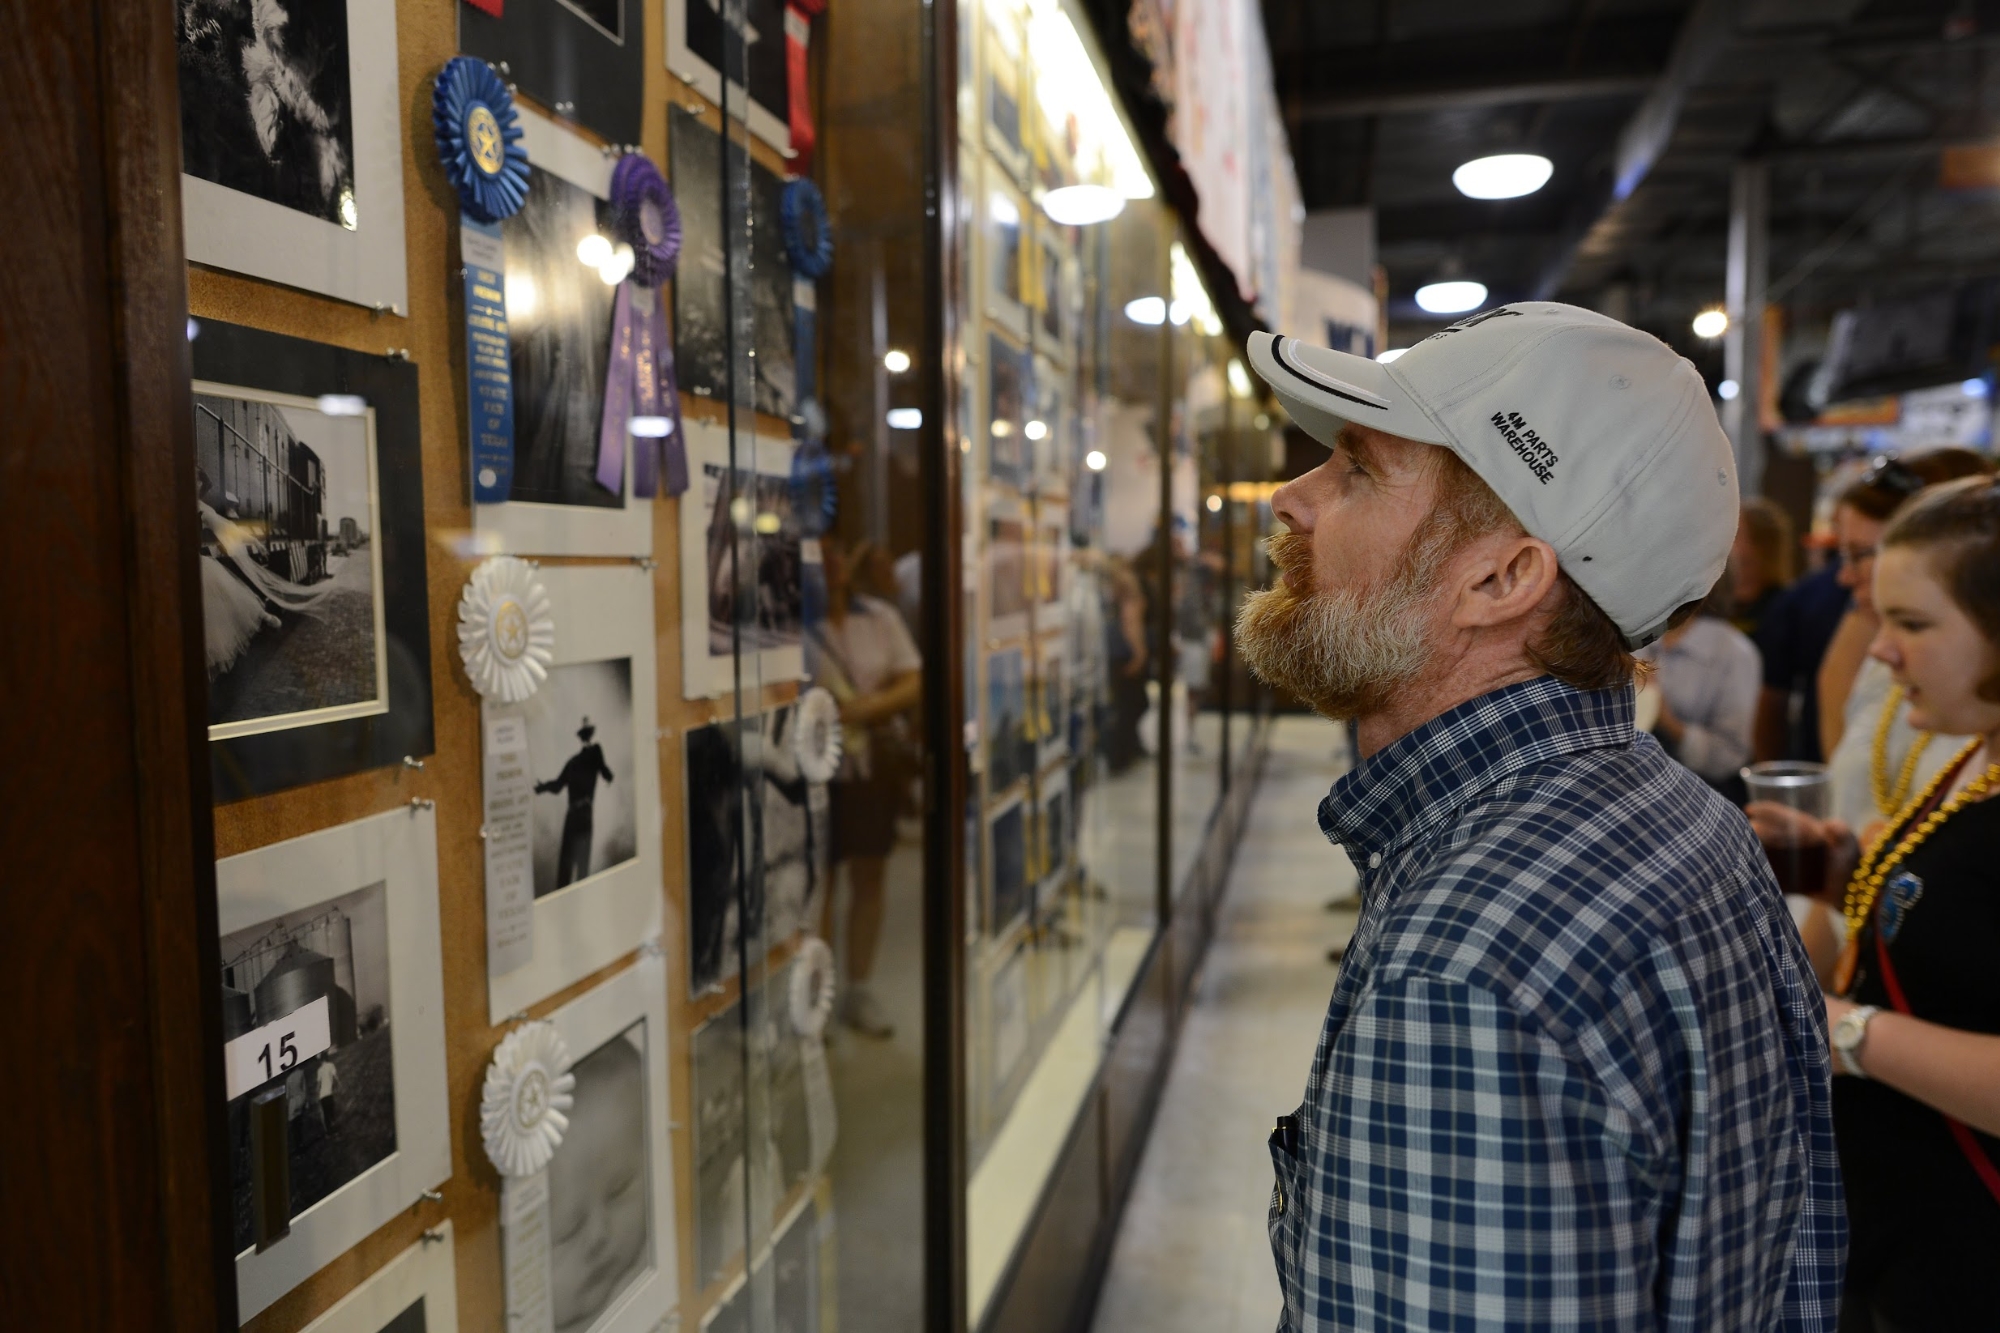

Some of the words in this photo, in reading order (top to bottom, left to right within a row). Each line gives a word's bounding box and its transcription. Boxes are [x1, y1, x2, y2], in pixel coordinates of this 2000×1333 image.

[1491, 411, 1554, 485] WAREHOUSE
[1508, 412, 1527, 430] 4M
[1522, 429, 1558, 467] PARTS
[257, 1031, 298, 1079] 15
